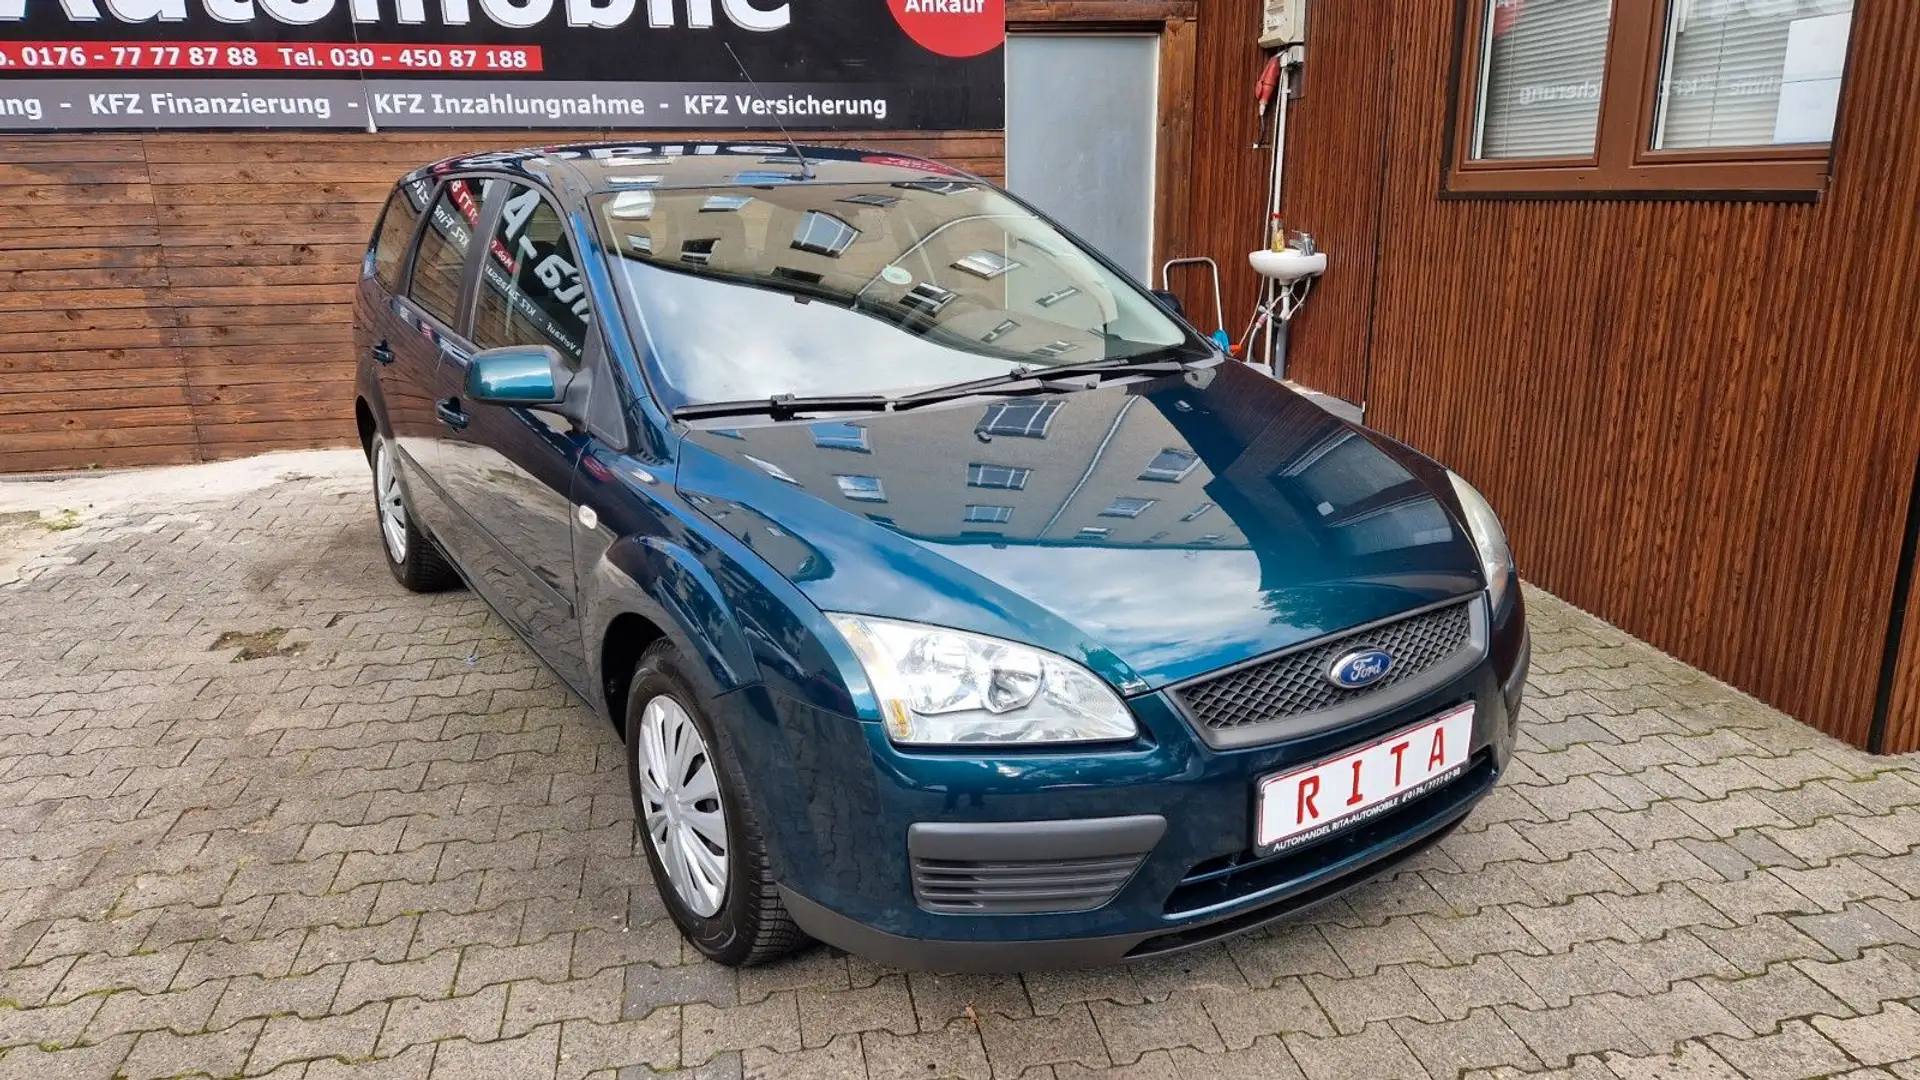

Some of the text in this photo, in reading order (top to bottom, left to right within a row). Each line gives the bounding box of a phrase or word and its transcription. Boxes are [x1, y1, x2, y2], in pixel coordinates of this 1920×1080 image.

[21, 46, 87, 66] 0176
[110, 47, 142, 66] 77
[150, 47, 180, 66] 77
[188, 47, 218, 66] 87
[226, 47, 258, 66] 88
[277, 47, 323, 66] Tel.
[330, 48, 375, 67] 030
[398, 49, 442, 67] 450
[449, 49, 477, 68] 87
[486, 50, 527, 69] 188
[88, 93, 144, 114] KFZ
[150, 92, 331, 119] Finanzierung
[375, 94, 425, 115] KFZ
[431, 93, 645, 119] Inzahlungnahme
[684, 94, 729, 115] KFZ
[734, 94, 887, 119] Versicherung
[1351, 656, 1381, 681] Ford
[1296, 727, 1445, 825] RITA
[1272, 824, 1331, 853] AUTOHANDEL
